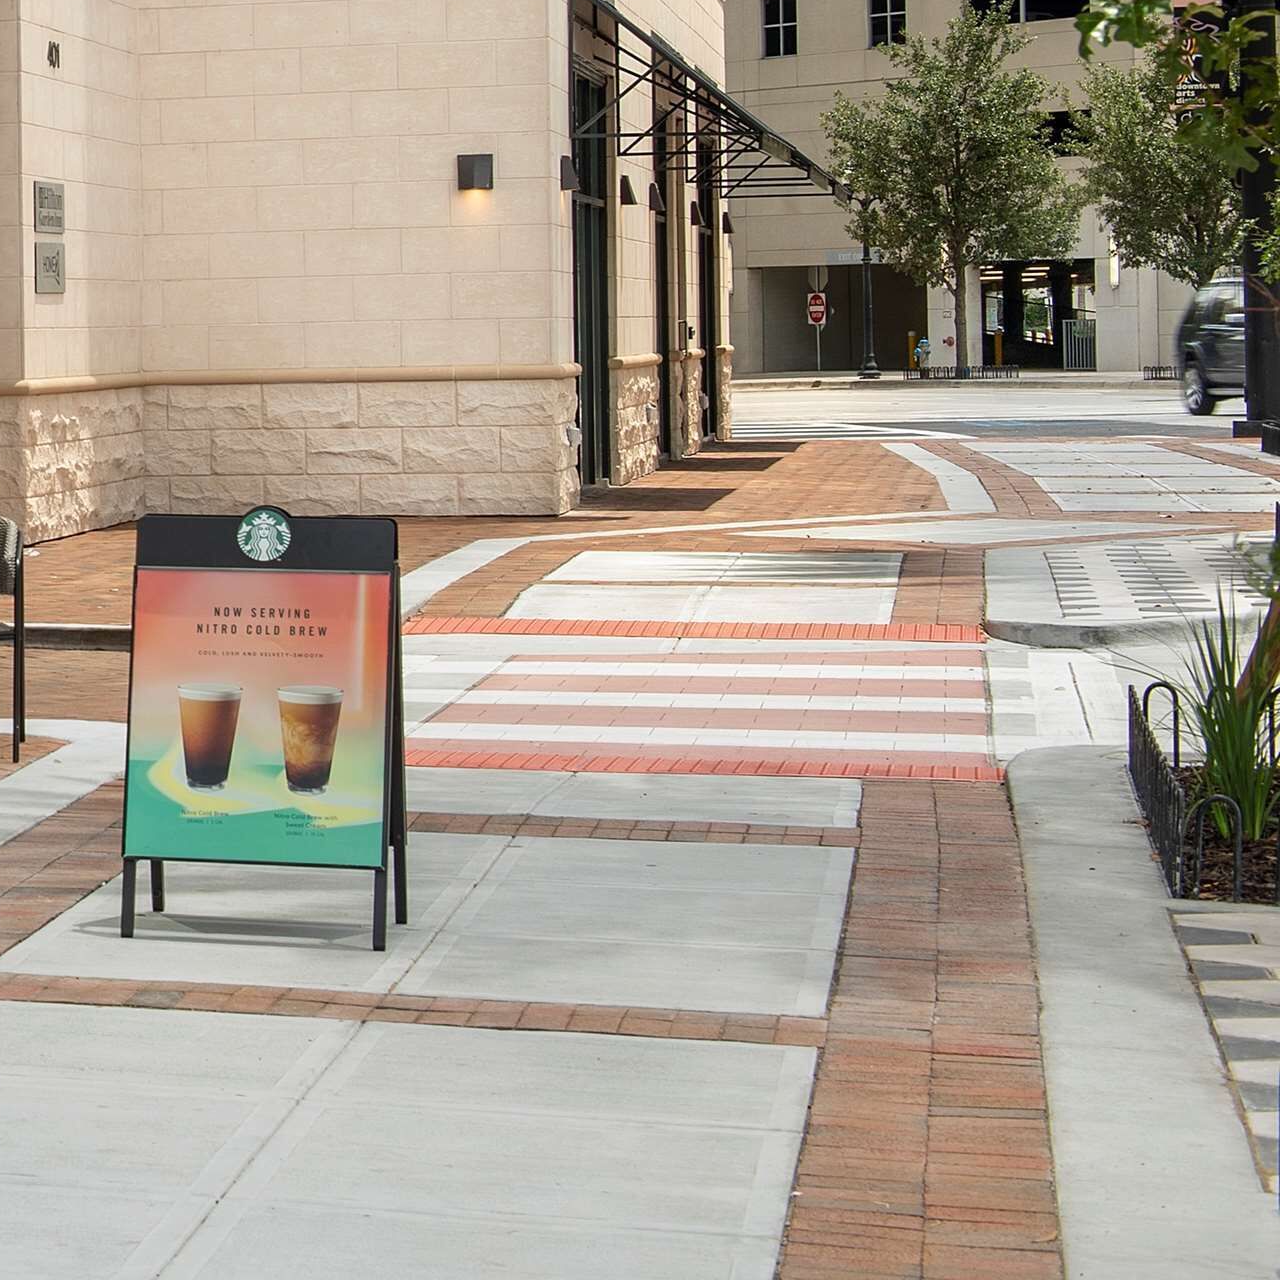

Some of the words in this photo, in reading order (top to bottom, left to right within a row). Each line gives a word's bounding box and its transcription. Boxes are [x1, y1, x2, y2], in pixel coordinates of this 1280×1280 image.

[47, 40, 60, 69] 401
[214, 607, 242, 618] NOW
[251, 608, 311, 619] SERVING
[196, 623, 238, 635] NITRO
[245, 624, 280, 636] COLD
[289, 625, 328, 637] BREW
